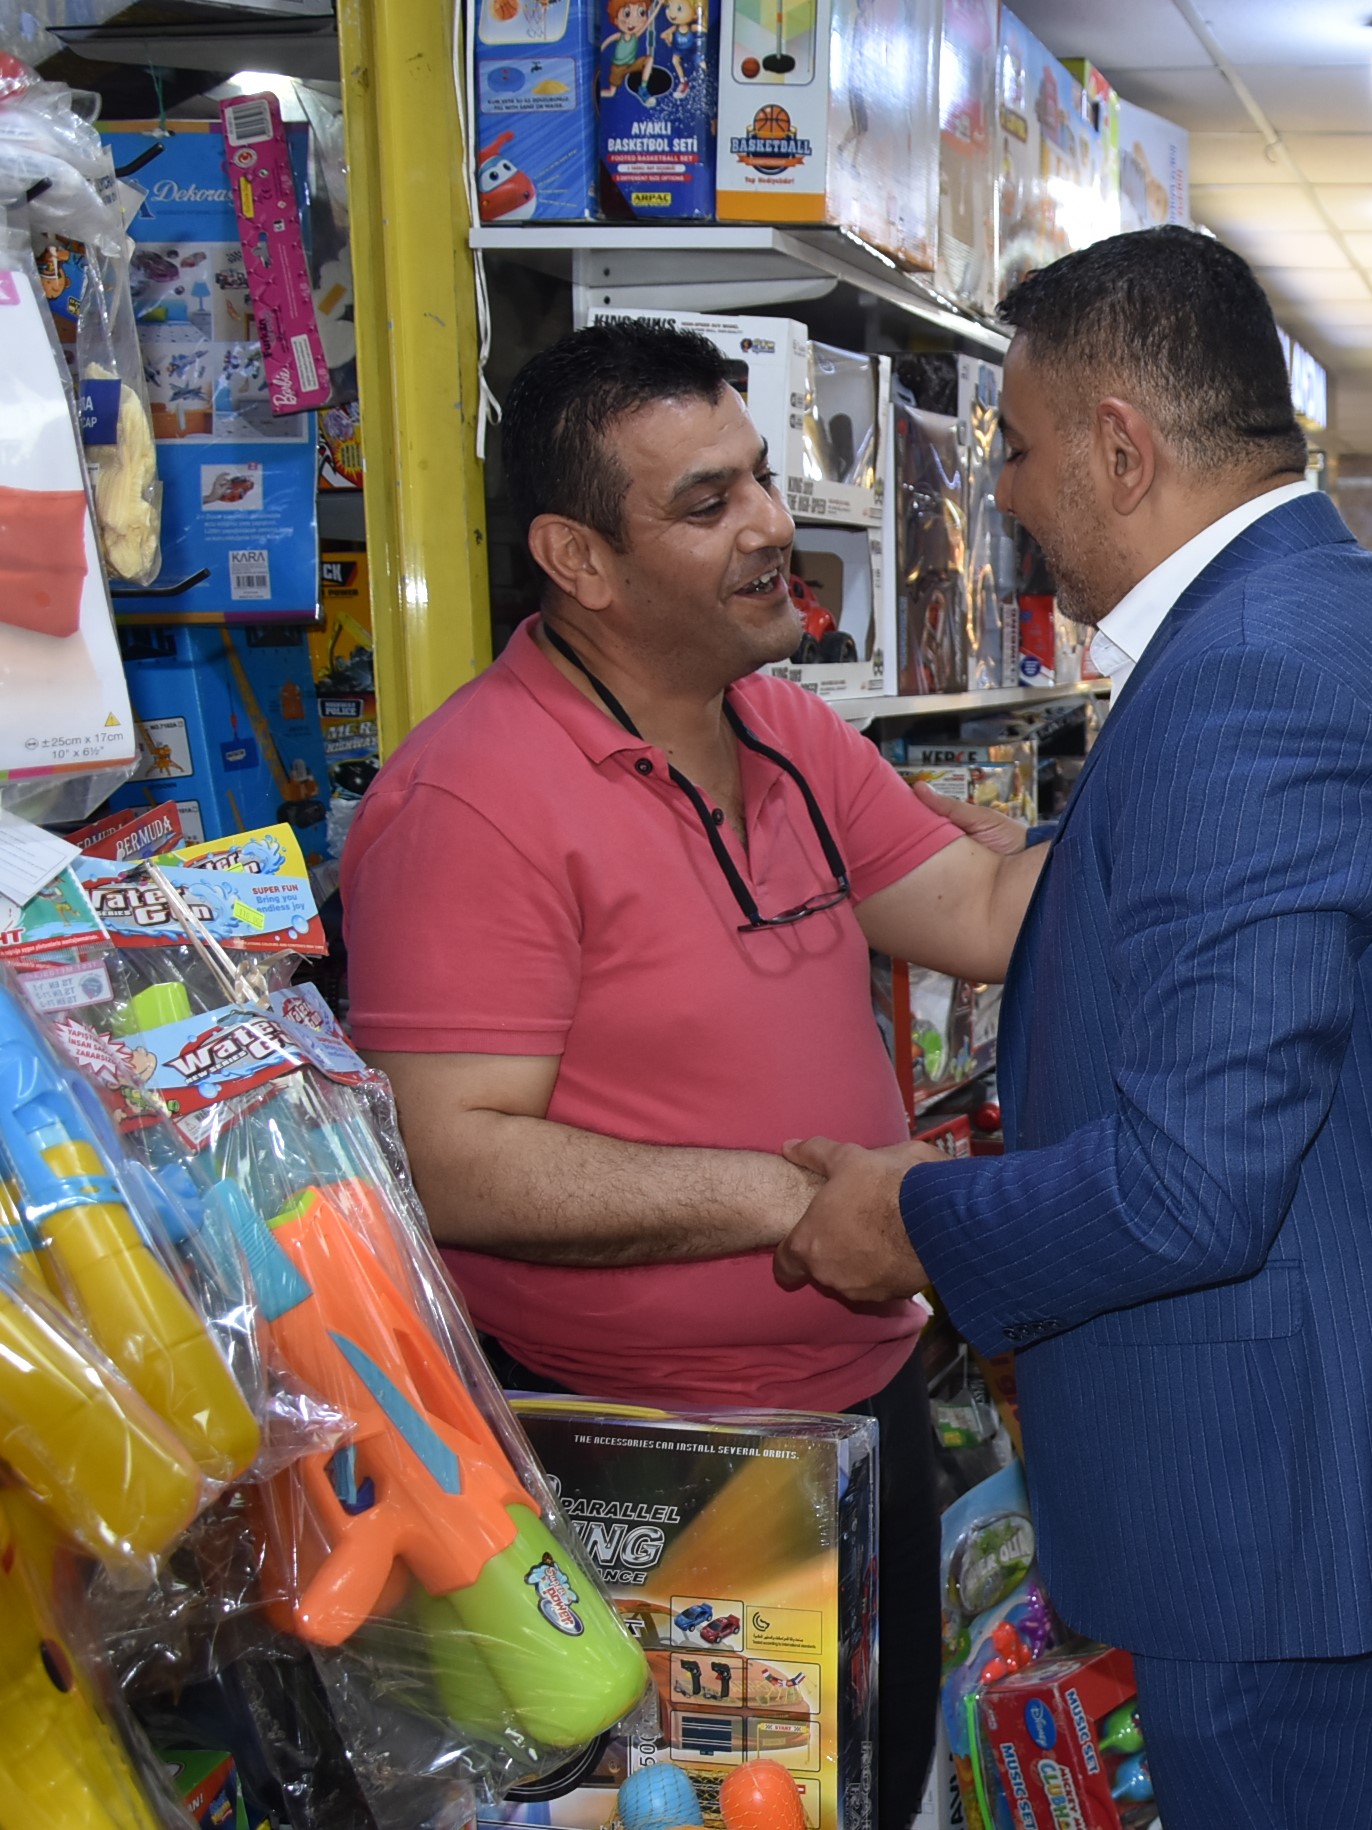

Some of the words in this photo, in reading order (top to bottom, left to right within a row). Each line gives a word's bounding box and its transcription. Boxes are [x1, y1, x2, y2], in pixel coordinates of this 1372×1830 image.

[631, 121, 671, 136] AYAKLI
[607, 138, 669, 152] BASKETBOL
[731, 138, 811, 154] BASKETBALL
[637, 154, 679, 162] BASKETBALL
[272, 364, 298, 407] Barbie
[231, 551, 266, 563] KARA
[323, 563, 343, 582] CK
[94, 732, 124, 743] 17cm
[115, 815, 173, 861] BERMUDA
[252, 885, 281, 895] SUPER
[281, 884, 299, 892] FUN
[256, 895, 280, 904] Bring
[282, 895, 298, 903] you
[209, 1050, 249, 1073] SERIES
[574, 1434, 593, 1444] THE
[593, 1436, 655, 1449] ACCESSORIES
[655, 1440, 675, 1451] CAN
[676, 1442, 716, 1454] INSTALL
[717, 1445, 762, 1457] SEVERAL
[762, 1448, 801, 1461] ORBITS.
[560, 1497, 681, 1524] PARALLEL
[570, 1519, 666, 1569] ING
[1065, 1687, 1092, 1744] MUSIC
[1082, 1742, 1100, 1775] SET
[1000, 1742, 1029, 1798] MUSIC
[1017, 1798, 1039, 1830] SET
